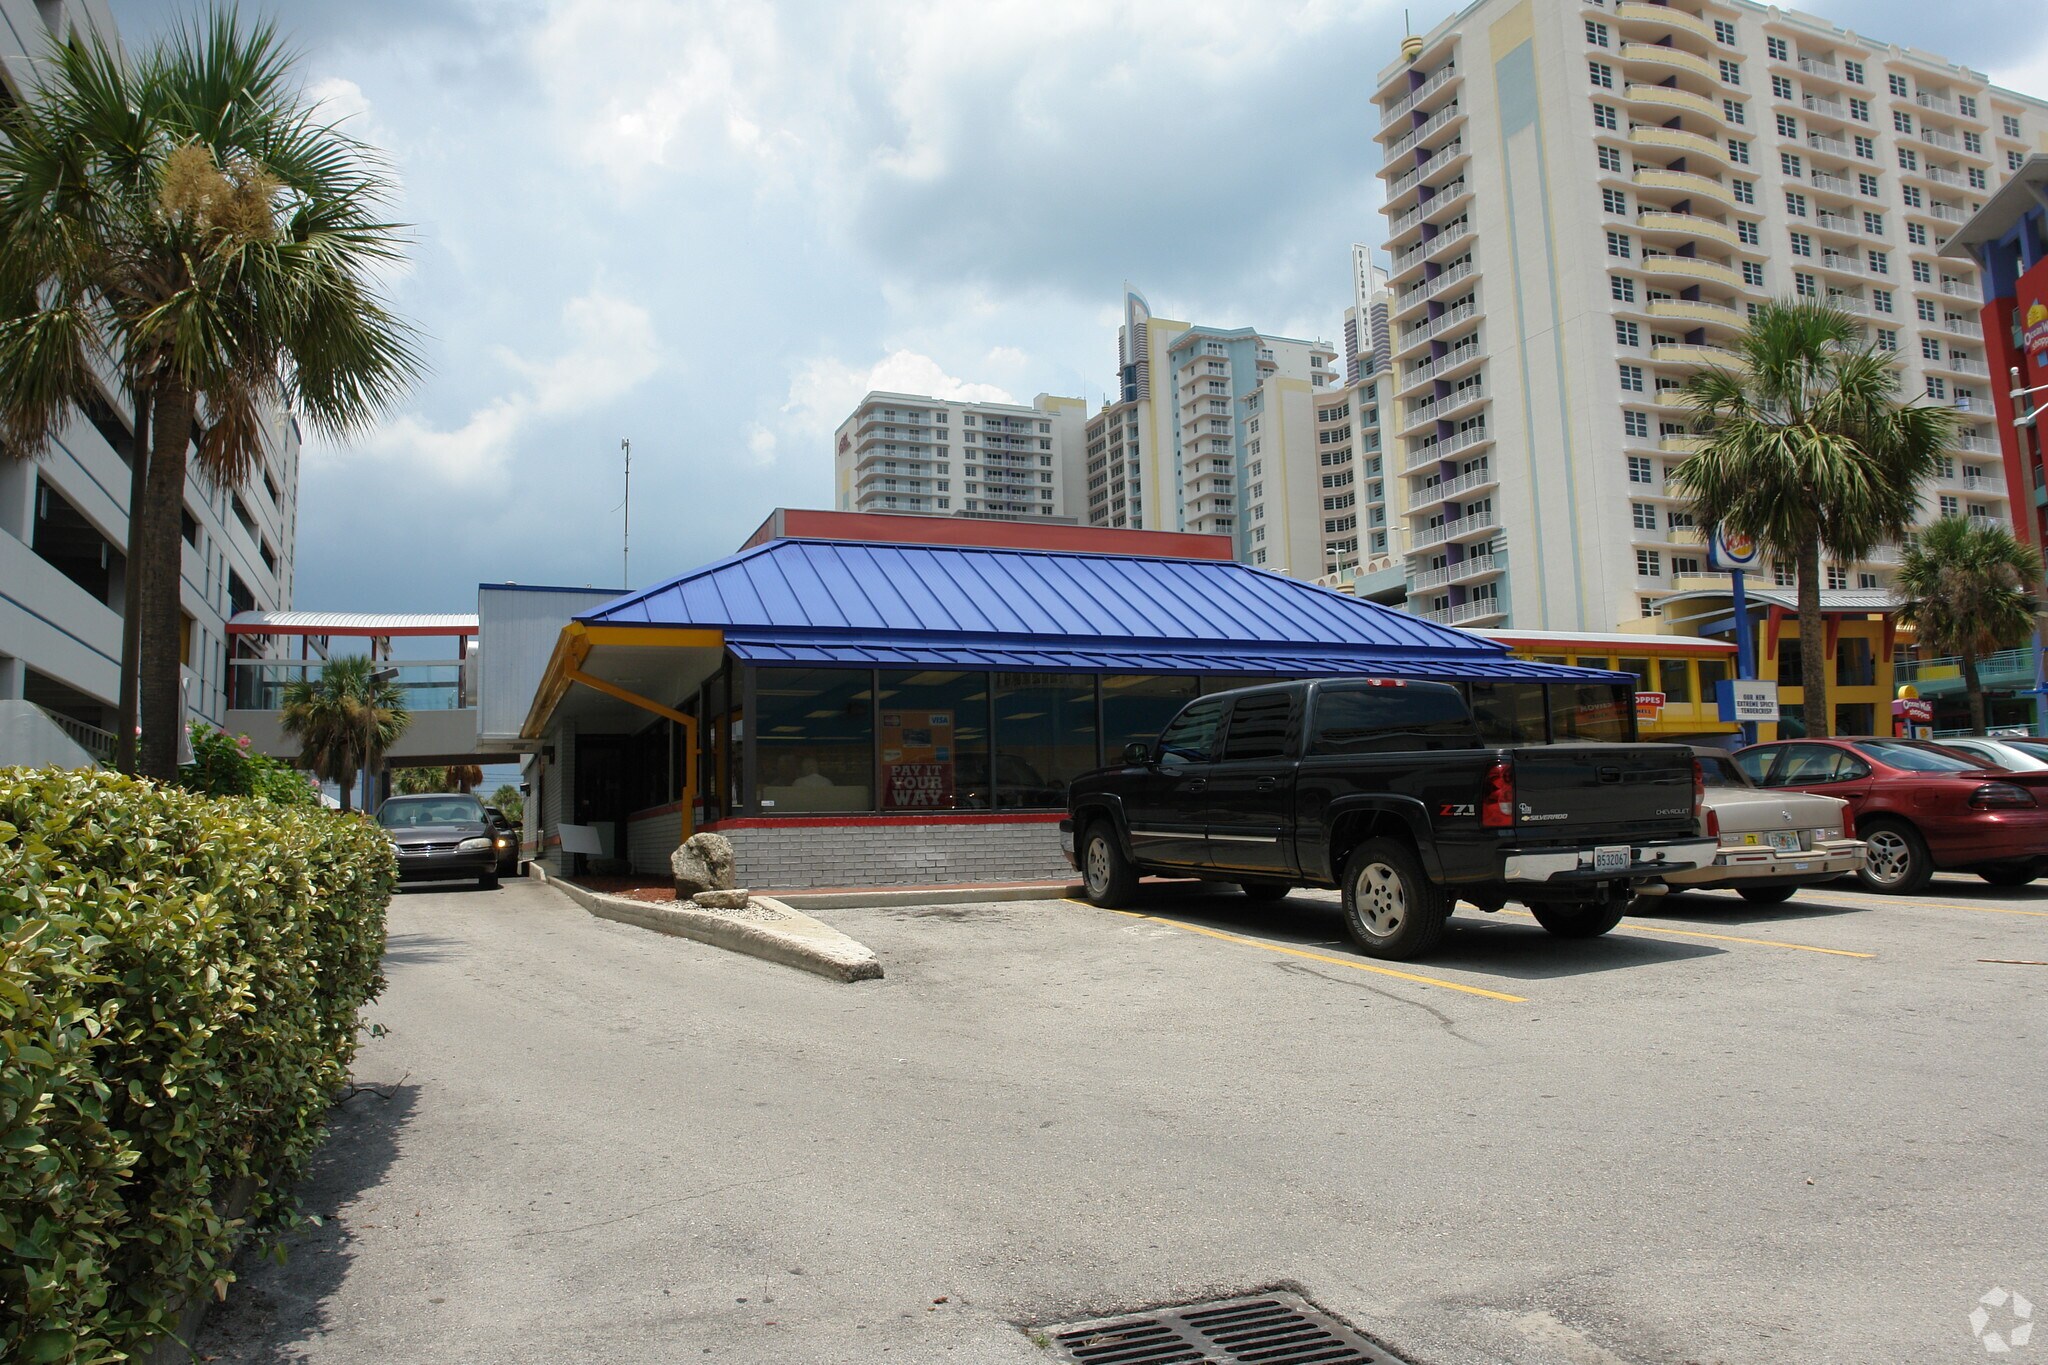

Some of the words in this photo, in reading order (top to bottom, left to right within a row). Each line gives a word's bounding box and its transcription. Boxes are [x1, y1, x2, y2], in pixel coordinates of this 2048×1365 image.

[931, 716, 949, 724] VISA
[891, 765, 922, 776] PAY
[926, 765, 942, 776] IT
[891, 776, 943, 789] YOUR
[891, 789, 943, 806] WAY
[1440, 804, 1475, 816] Z71
[1529, 813, 1569, 821] SILVERADO
[1596, 853, 1628, 867] B532067
